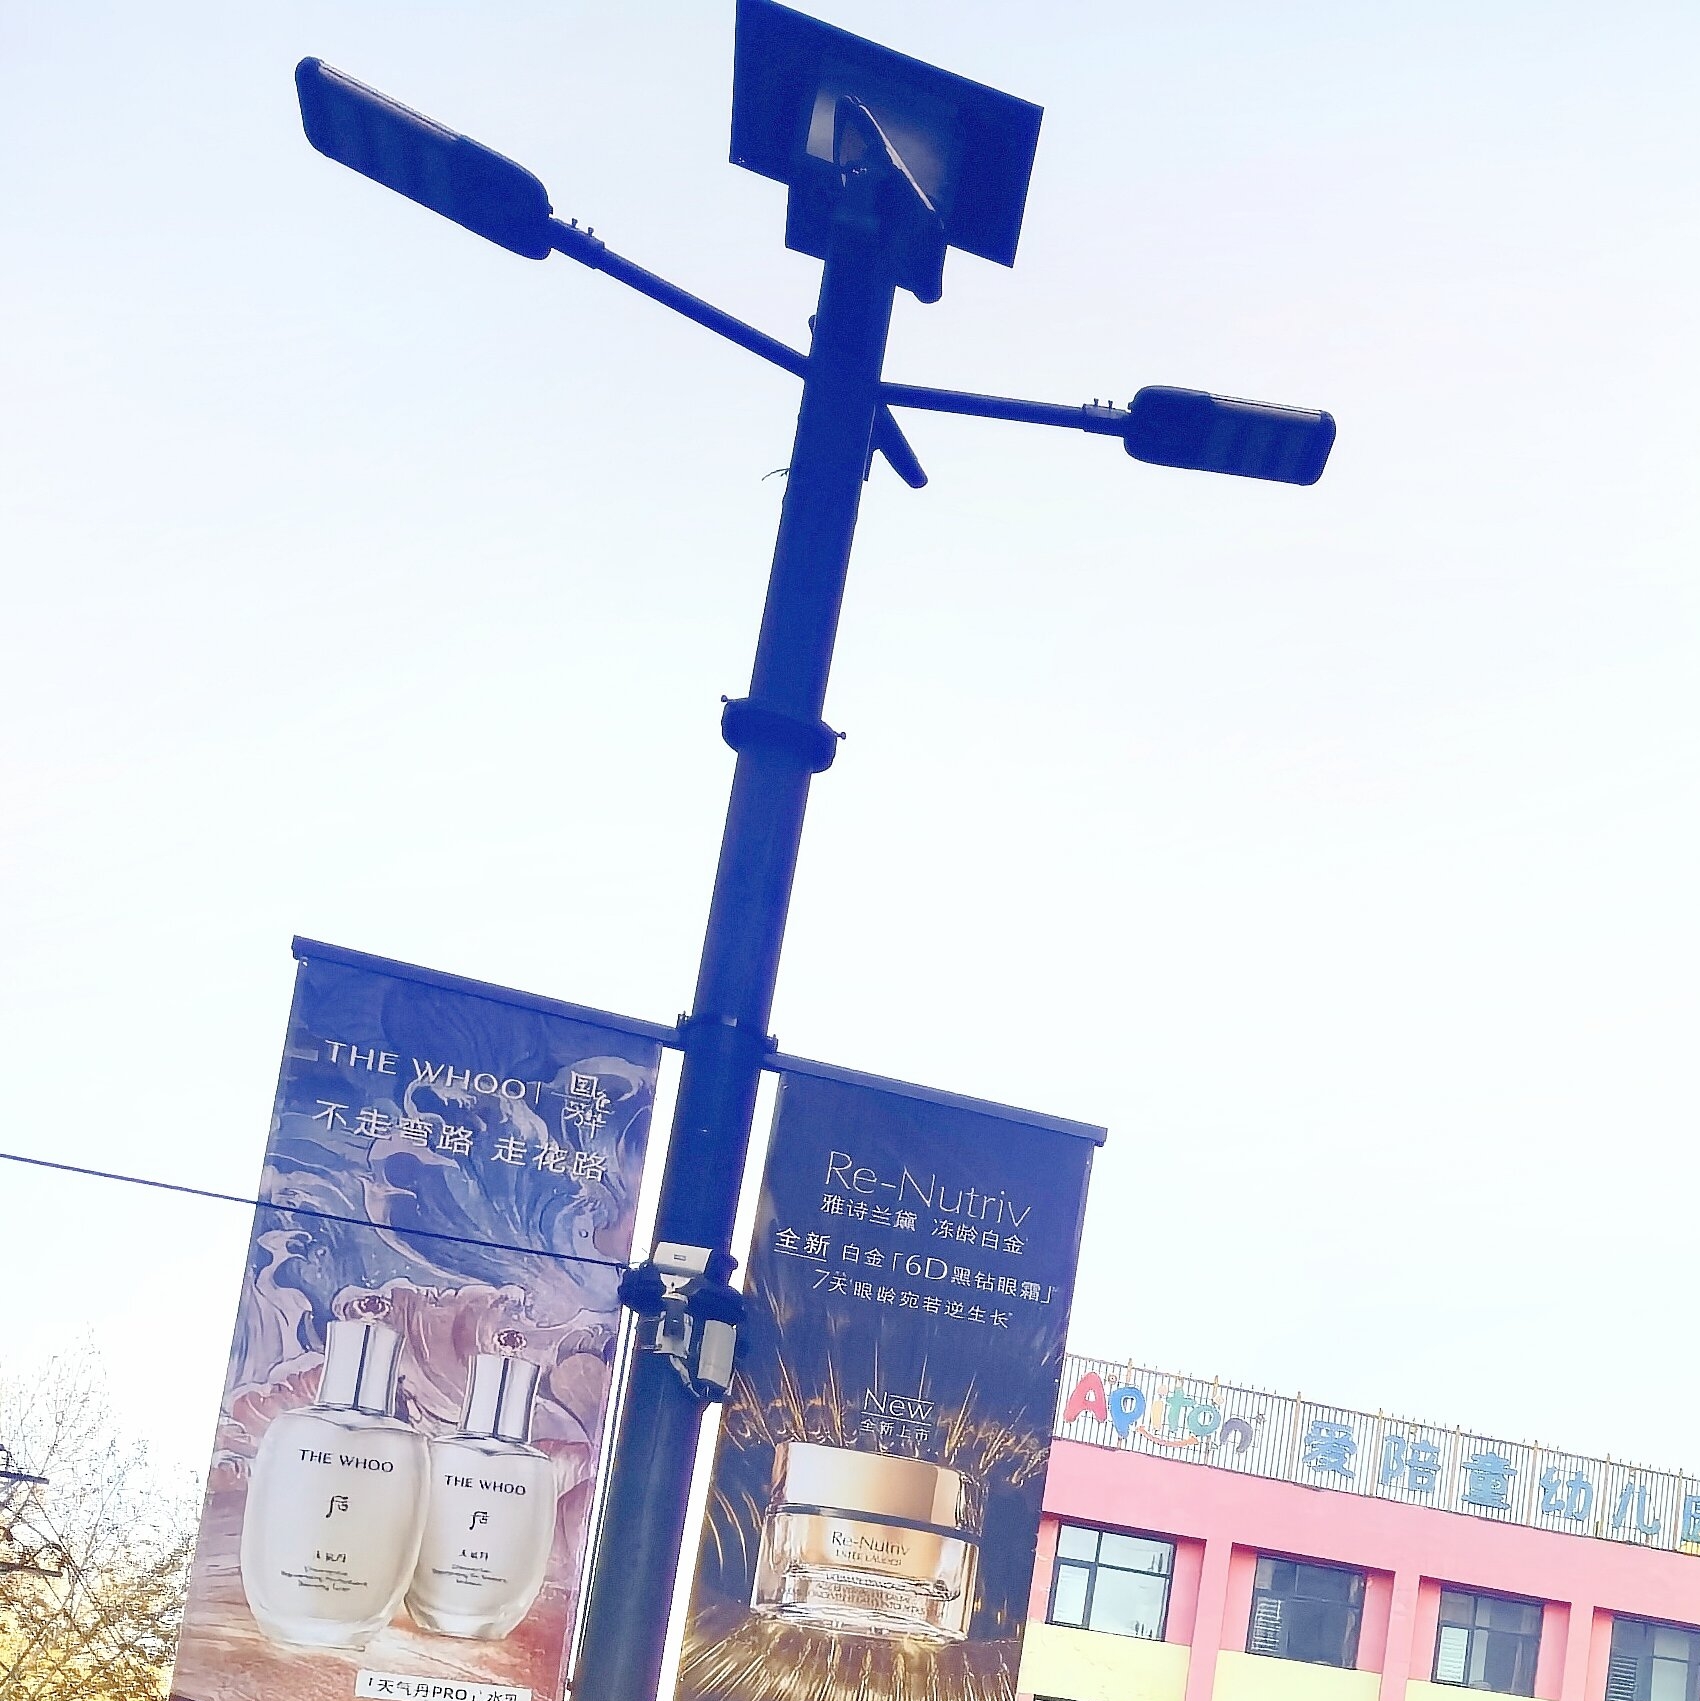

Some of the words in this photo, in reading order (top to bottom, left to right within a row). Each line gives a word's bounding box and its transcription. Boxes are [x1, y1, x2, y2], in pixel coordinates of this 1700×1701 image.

[325, 1039, 399, 1076] THE
[412, 1058, 526, 1100] WHOO
[312, 1099, 474, 1157] 不走弯路
[491, 1137, 608, 1182] 走花路
[825, 1150, 1031, 1228] Re-Nutriv
[820, 1193, 918, 1232] 雅诗兰黛
[931, 1217, 1025, 1255] 冻龄白金
[775, 1227, 831, 1257] 全新
[862, 1388, 934, 1422] New
[859, 1418, 930, 1443] 全新上市
[300, 1449, 332, 1465] THE
[339, 1454, 394, 1474] WHOO
[444, 1474, 473, 1489] THE
[479, 1479, 527, 1497] WHOO
